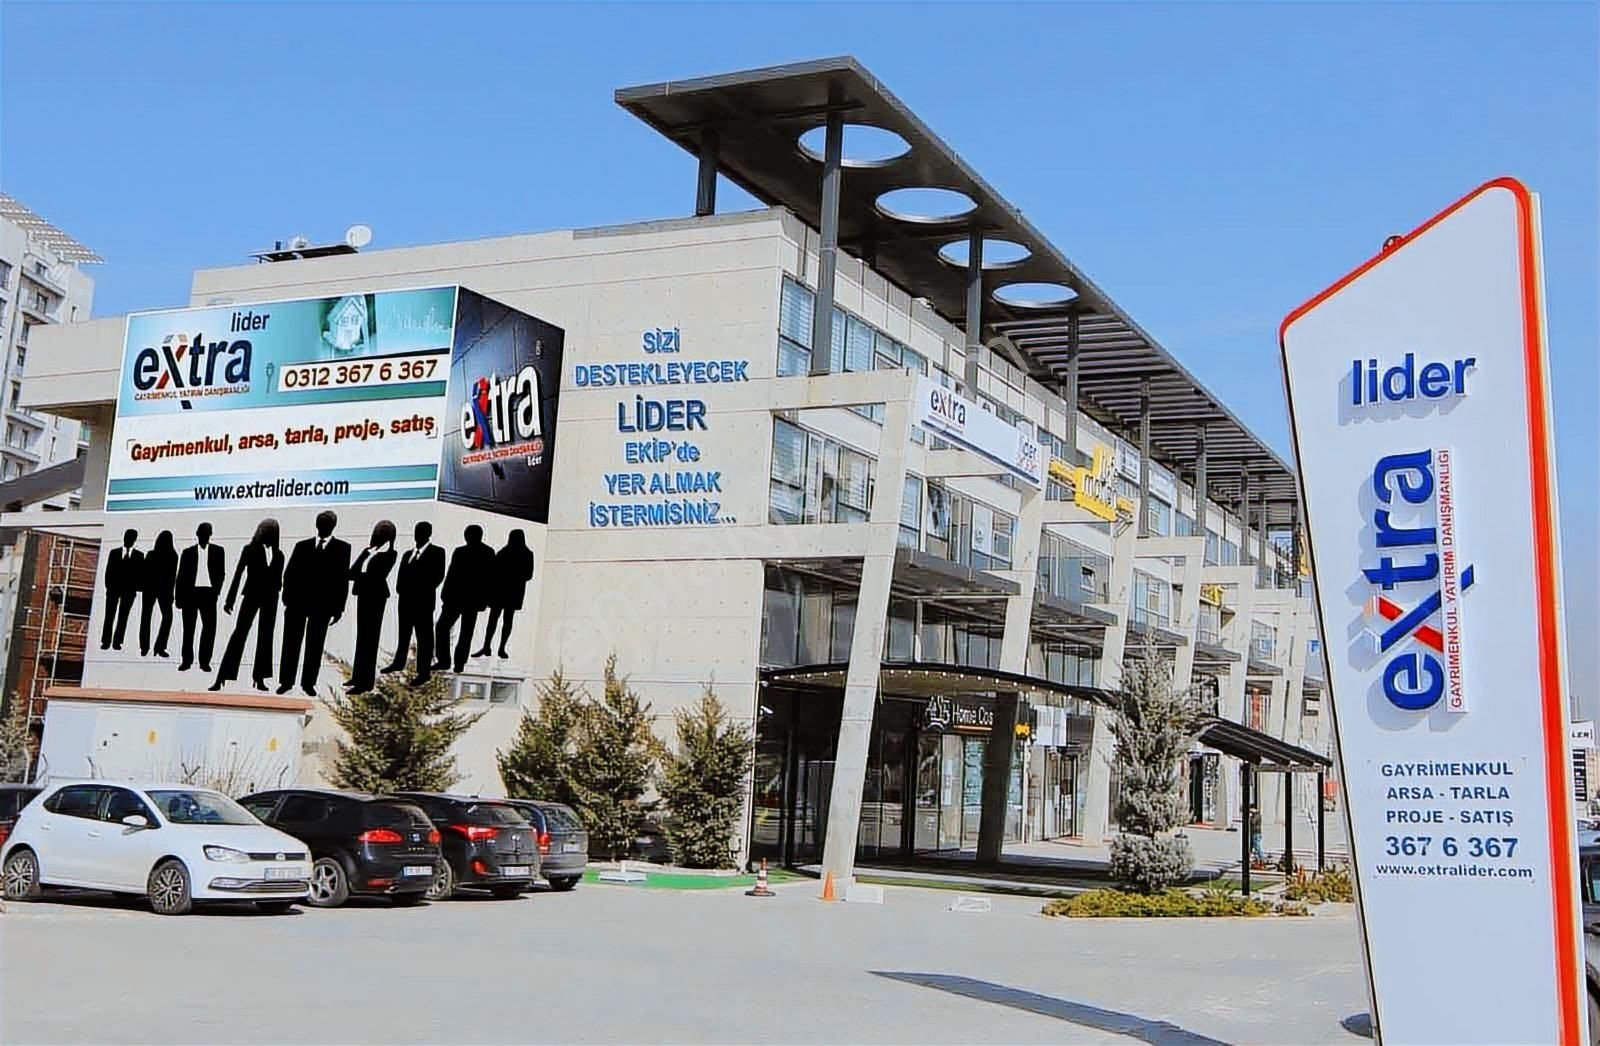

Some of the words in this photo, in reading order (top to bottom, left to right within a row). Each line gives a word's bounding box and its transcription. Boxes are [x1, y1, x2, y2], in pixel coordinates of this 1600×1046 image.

[230, 310, 270, 333] lider
[642, 327, 680, 354] SİZİ
[133, 331, 252, 391] extra
[285, 365, 330, 389] 0312
[335, 363, 373, 385] 367
[380, 361, 393, 382] 6
[400, 359, 438, 380] 367
[575, 361, 750, 387] DESTEKLEYECEK
[1352, 352, 1477, 406] lider
[460, 365, 542, 449] extra
[618, 394, 708, 433] LİDER
[930, 389, 966, 425] extra
[131, 434, 234, 463] Gayrimenkul,
[238, 428, 279, 451] arsa,
[285, 422, 329, 446] tarla,
[334, 417, 385, 443] proje,
[390, 414, 435, 437] satış
[194, 478, 349, 502] www.extralider.com
[604, 473, 646, 496] YER
[649, 471, 723, 495] ALMAK
[1363, 448, 1446, 713] extra
[1444, 549, 1457, 607] YATIRIM
[952, 703, 977, 725] Home
[1380, 759, 1515, 778] GAYRİMENKUL
[1386, 786, 1435, 801] ARSA
[1449, 786, 1511, 801] TARLA
[1385, 809, 1444, 824] PROJE
[1459, 809, 1514, 827] SATIŞ
[1385, 836, 1432, 858] 367
[1442, 836, 1459, 858] 6
[1468, 836, 1519, 858] 367
[1375, 863, 1533, 880] www.extralider.com
